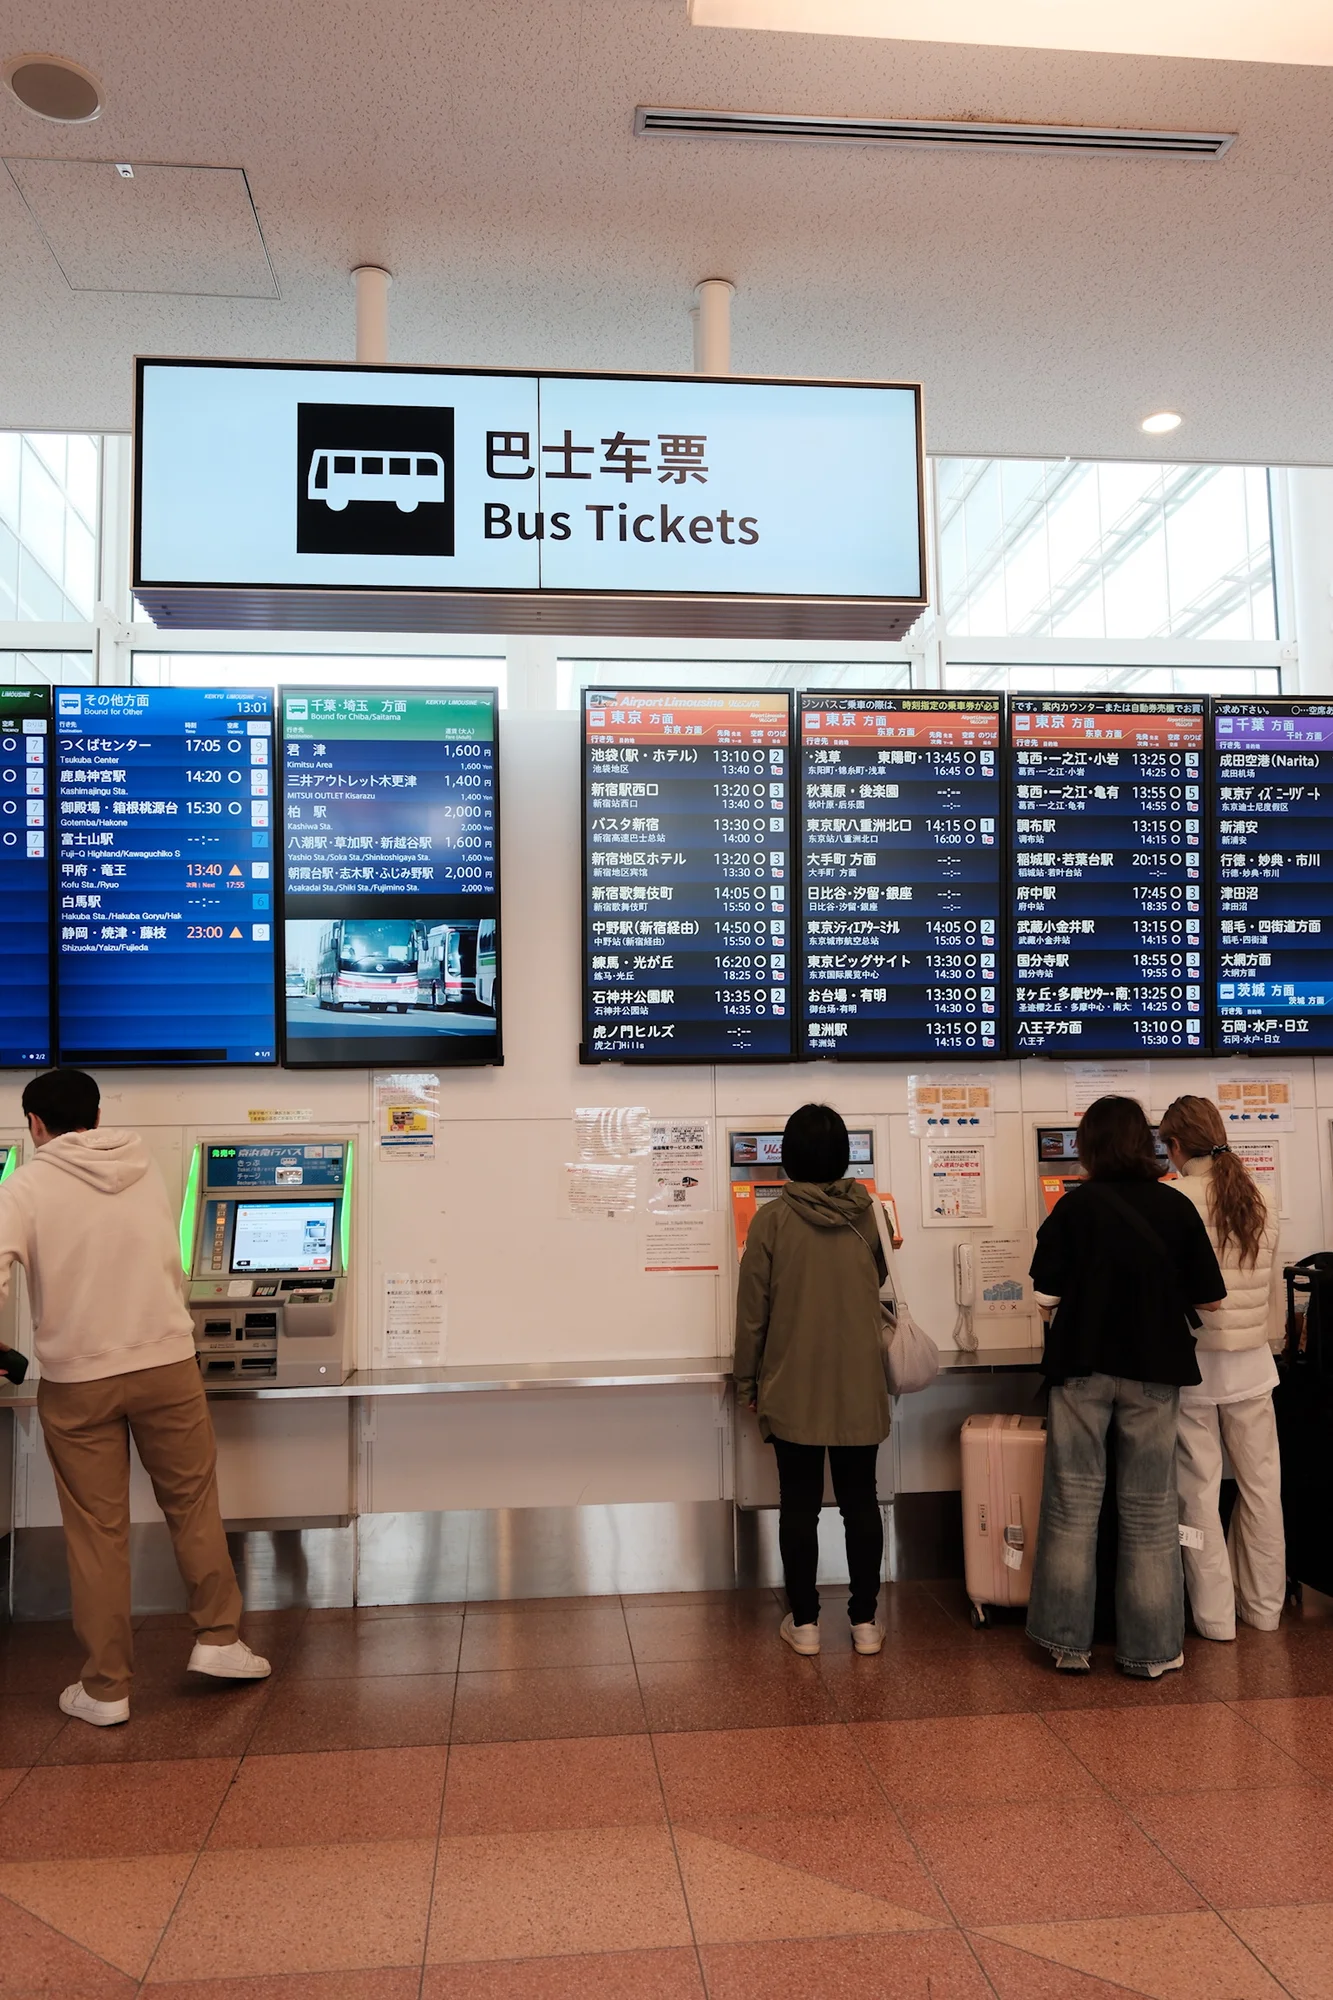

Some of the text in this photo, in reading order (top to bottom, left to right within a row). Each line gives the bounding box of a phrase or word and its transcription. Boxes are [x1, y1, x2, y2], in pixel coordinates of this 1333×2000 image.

[486, 430, 709, 486] 巴士车票
[483, 501, 760, 546] Bus Tickets
[84, 694, 149, 708] その他方面
[311, 700, 407, 713] 千葉・埼玉 方面
[620, 697, 723, 707] Airport Limousine
[123, 708, 143, 716] Other
[237, 702, 268, 713] 13:01
[611, 711, 673, 724] 東京 方面
[1036, 716, 1094, 728] 東京 方面
[1237, 718, 1294, 731] 千葉 方面
[60, 739, 151, 751] つくばセンター
[186, 739, 221, 752] 17:05
[445, 745, 480, 757] 1,600
[60, 756, 119, 764] Tsukuba Center
[591, 749, 779, 762] 池袋(駅・ホテル) 13:10 2
[926, 752, 960, 763] 13:45
[1017, 753, 1165, 765] 葛西・一之江・小岩 13:25
[1220, 754, 1319, 767] 成田空港(Narita)
[593, 765, 749, 774] 池袋地区 13:40
[61, 770, 221, 783] 鹿島神宮駅 14:20
[288, 775, 480, 788] 三井アウトレット木更津 1,400
[61, 788, 111, 797] Kashimajingu
[591, 783, 749, 796] 新宿駅西口 13:20
[807, 785, 898, 798] 秋葉原・後楽園
[1017, 786, 1166, 799] 葛西・一之江・亀有 13:55
[61, 802, 221, 814] 御殿場・箱根桃源台 15:30
[445, 806, 481, 818] 2,000
[1222, 803, 1288, 811] 东京迪士尼度假区
[61, 818, 128, 827] Gotemba/Hakone
[592, 819, 749, 830] バスタ新宿 13:30
[807, 819, 960, 832] 東京駅八重洲北口 14:15
[1017, 820, 1166, 832] 調布駅 13:15
[1220, 821, 1257, 833] 新浦安
[61, 833, 113, 846] 富士山駅
[288, 837, 481, 849] 八潮駅・草加駅・新越谷駅 1,600
[593, 834, 665, 842] 新宿高速巴士总站
[809, 835, 878, 843] 东京站八重洲北口
[1019, 835, 1044, 843] 调布站
[61, 850, 85, 858] Fuji-Q
[87, 850, 173, 858] Highland/Kawaguchiko
[349, 854, 416, 862] Sta./Shinkoshigaya
[592, 853, 749, 865] 新宿地区ホテル 13:20
[807, 854, 876, 866] 大手町 方面
[1017, 853, 1166, 866] 稲城駅・若葉台駅 20:15
[1221, 854, 1320, 866] 行徳・妙典・市川
[62, 864, 222, 877] 甲府・竜王 13:40
[288, 867, 481, 879] 朝霞台駅・志木駅・ふじみ野駅 2,000
[81, 881, 119, 890] Sta./Ryuo
[323, 884, 356, 892] Sta./Shiki
[358, 884, 405, 892] Sta./Fujimino
[592, 887, 750, 899] 新宿歌舞伎町 14:05
[808, 887, 912, 900] 日比谷・汐留・銀座
[1017, 887, 1166, 899] 府中駅 17:45
[1221, 887, 1258, 900] 津田沼
[62, 896, 101, 908] 白馬駅
[62, 912, 182, 921] Hakuba Sta./Hakuba Goryu/Hak
[593, 921, 750, 934] 中野駅(新宿経由) 14:50
[926, 922, 960, 932] 14:05
[1017, 921, 1166, 933] 武蔵小金井駅 13:15
[1221, 920, 1321, 933] 稲毛・四街道方面
[62, 927, 222, 940] 静岡・焼津・藤枝 23:00
[62, 944, 148, 952] Shizuoka/Yaizu/Fujieda
[592, 956, 750, 969] 練馬・光が丘 16:20
[808, 955, 961, 968] 東京ビッグサイト 13:30
[1018, 955, 1167, 967] 国分寺駅 18:55
[1221, 954, 1271, 966] 大網方面
[593, 990, 750, 1004] 石神井公園駅 13:35
[808, 989, 961, 1002] お台場・有明 13:30
[593, 1025, 674, 1038] 虎ノ門ヒルズ
[808, 1023, 961, 1036] 豊洲駅 13:15
[1018, 1021, 1167, 1034] 八王子方面 13:10
[1222, 1020, 1309, 1032] 石岡・水戸・日立
[595, 1042, 644, 1050] 虎之门Hills
[212, 1149, 236, 1157] 発売中
[238, 1148, 301, 1156] 京浜急行バス
